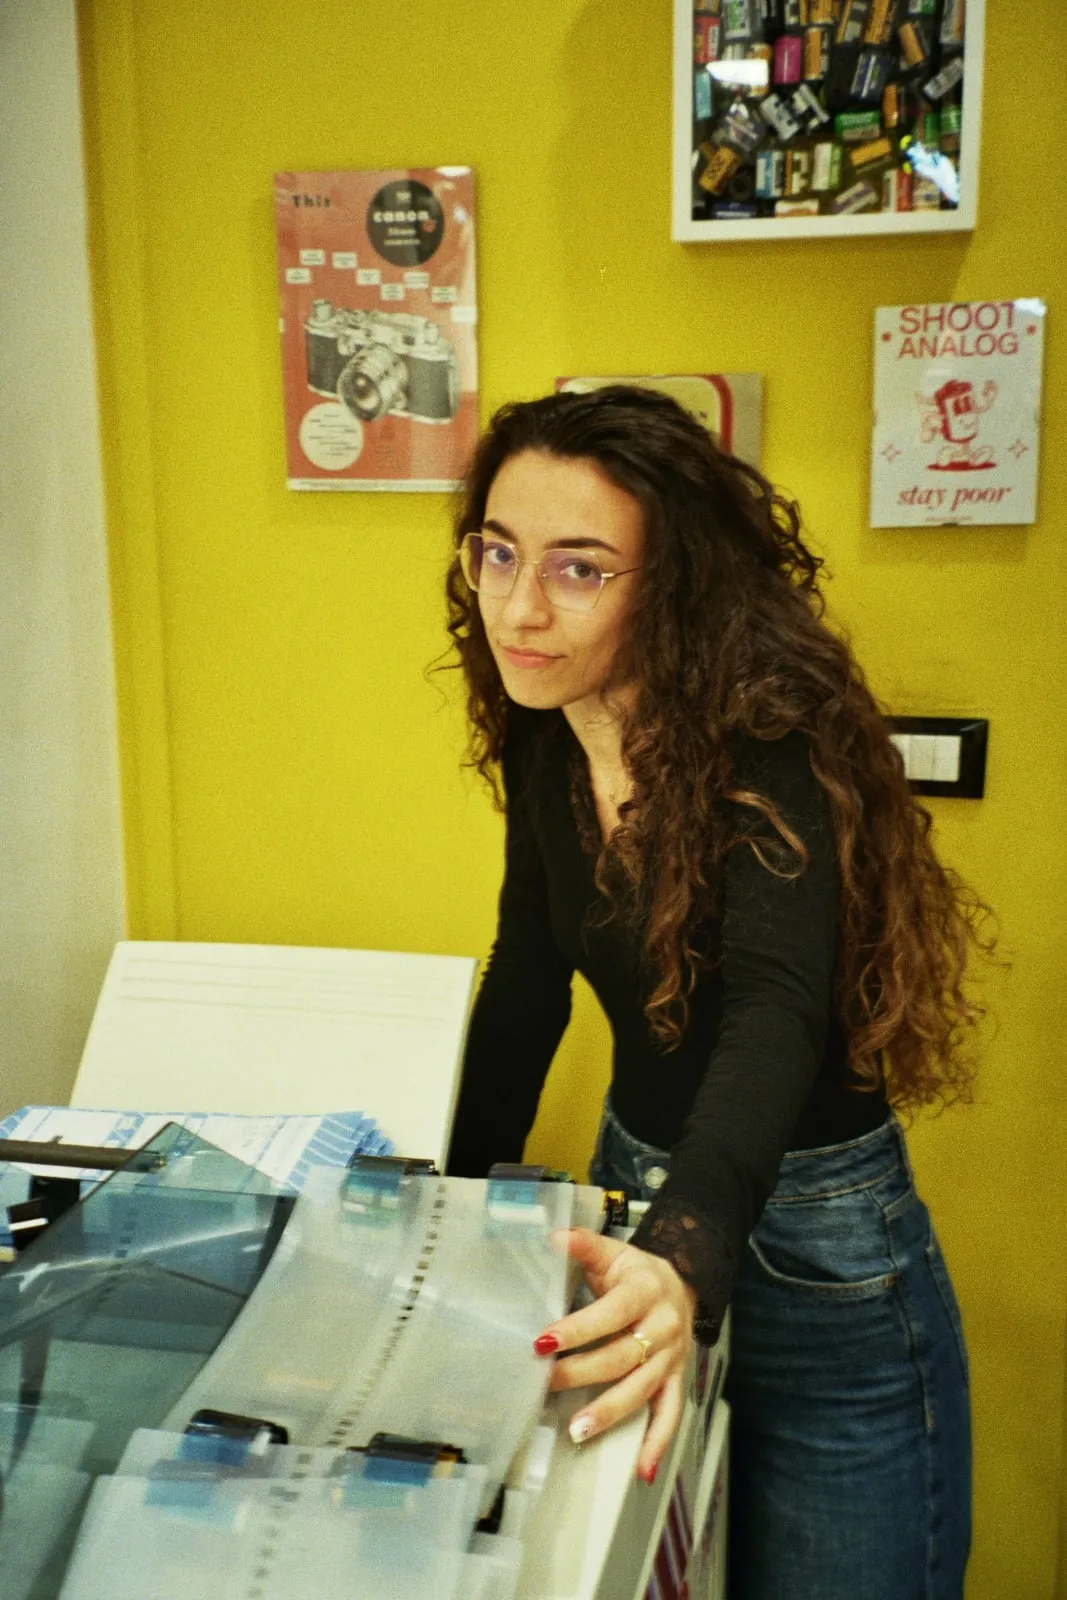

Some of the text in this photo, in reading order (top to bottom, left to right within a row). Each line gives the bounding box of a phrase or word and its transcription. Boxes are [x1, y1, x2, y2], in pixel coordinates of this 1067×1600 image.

[899, 302, 1016, 334] SHOOT
[898, 332, 1019, 358] ANALOG
[896, 485, 1014, 511] stay poor
